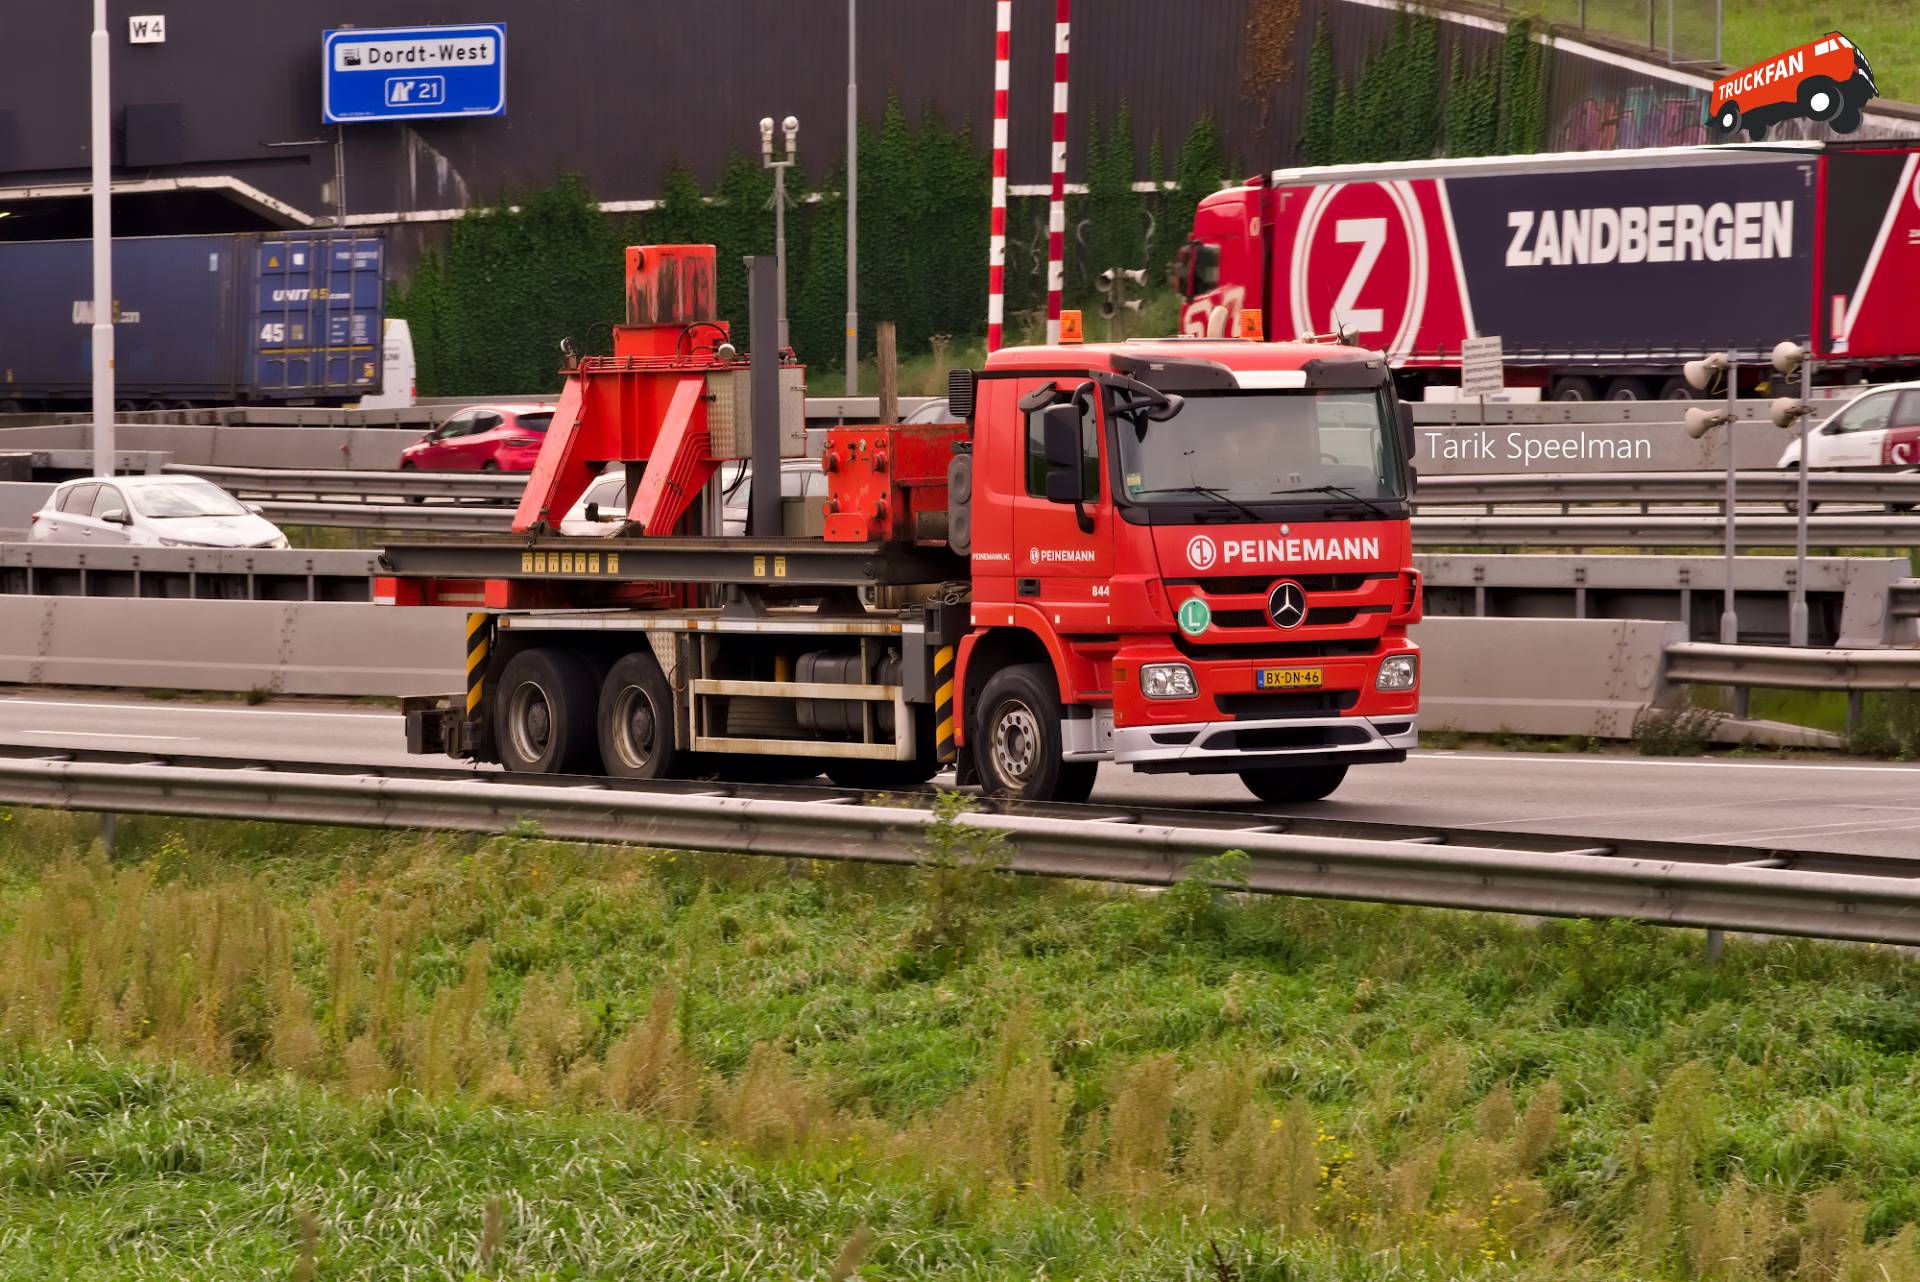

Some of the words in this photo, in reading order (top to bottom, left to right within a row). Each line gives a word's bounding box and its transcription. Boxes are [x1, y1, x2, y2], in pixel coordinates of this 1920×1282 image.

[368, 43, 488, 65] Dordt-West
[418, 82, 438, 99] 21
[1505, 199, 1794, 267] ZANDBERGEN
[1330, 217, 1389, 333] Z
[260, 323, 285, 343] 45
[972, 552, 1011, 561] PEINEMANN.NL
[1041, 550, 1096, 562] PEINEMANN
[1223, 536, 1381, 564] PEINEMANN
[1091, 585, 1110, 597] 844
[1187, 606, 1201, 628] L
[1266, 671, 1320, 685] BX-DN-46
